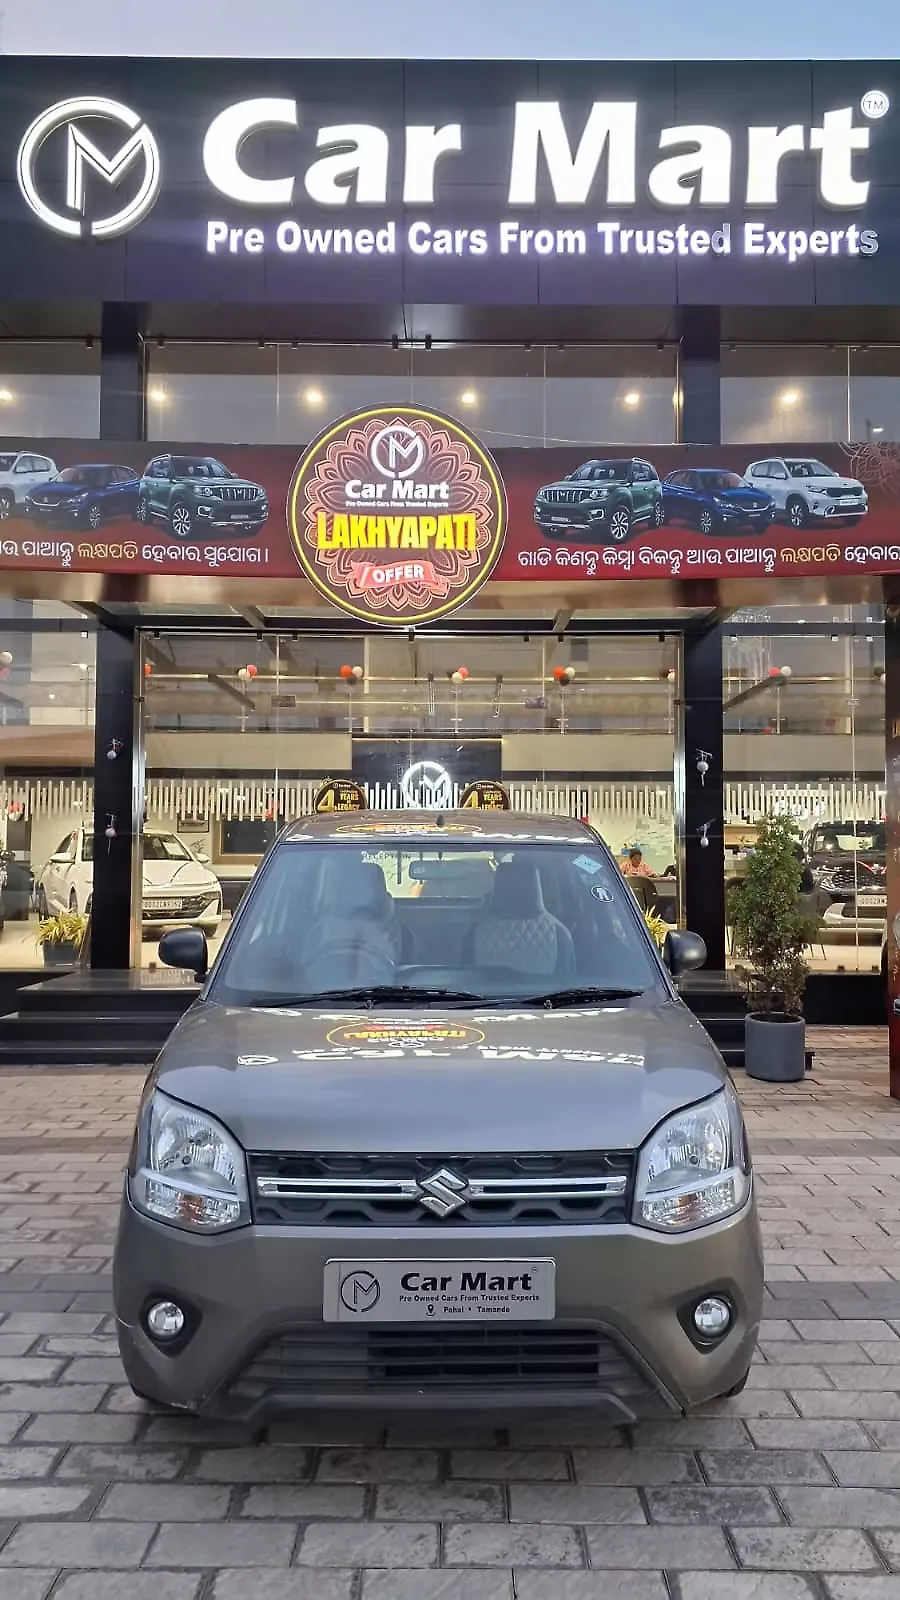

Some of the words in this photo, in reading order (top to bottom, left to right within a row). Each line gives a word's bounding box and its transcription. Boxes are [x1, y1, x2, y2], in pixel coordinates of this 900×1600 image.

[203, 97, 463, 207] Car
[508, 101, 871, 207] Mart
[206, 220, 265, 254] Pre
[276, 220, 396, 254] Owned
[408, 221, 488, 254] Cars
[500, 222, 586, 254] From
[597, 222, 731, 255] Trusted
[744, 222, 879, 262] Experts
[344, 479, 386, 499] Car
[392, 479, 450, 499] Mart
[316, 511, 477, 551] LAKHYAPATI
[78, 541, 138, 558] ଲକ୍ଷପତି
[142, 545, 202, 563] ହେବାର
[686, 548, 722, 565] ଆଉ
[780, 543, 840, 563] ଲକ୍ଷପତି
[371, 564, 425, 583] OFFER
[318, 789, 335, 812] 4
[339, 793, 359, 801] YEARS
[483, 793, 502, 801] YEARS
[400, 1272, 452, 1292] Car
[460, 1272, 532, 1291] Mart
[511, 1294, 540, 1302] Experts
